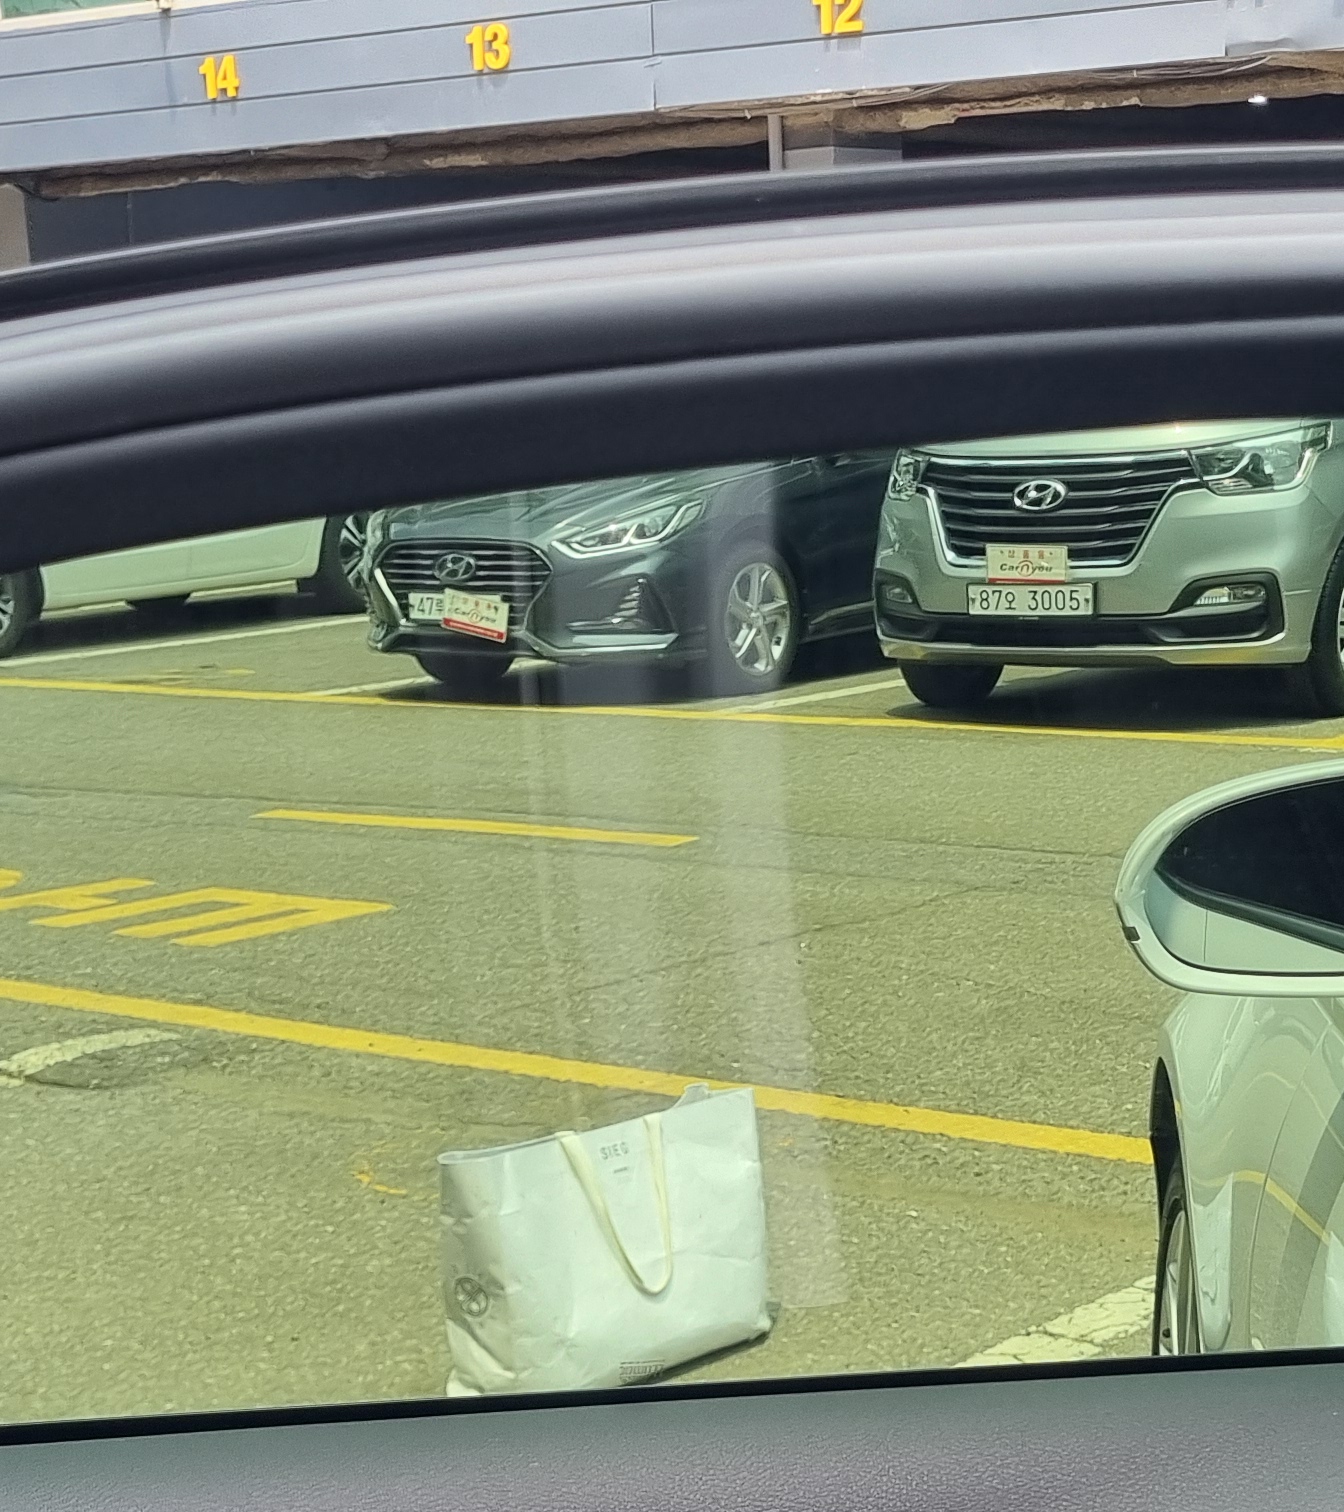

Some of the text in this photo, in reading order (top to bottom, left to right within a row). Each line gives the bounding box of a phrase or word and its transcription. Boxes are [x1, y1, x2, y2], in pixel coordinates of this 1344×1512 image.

[813, 0, 864, 35] 12
[465, 23, 511, 71] 13
[198, 54, 240, 100] 14
[979, 589, 1080, 611] 87오 3005
